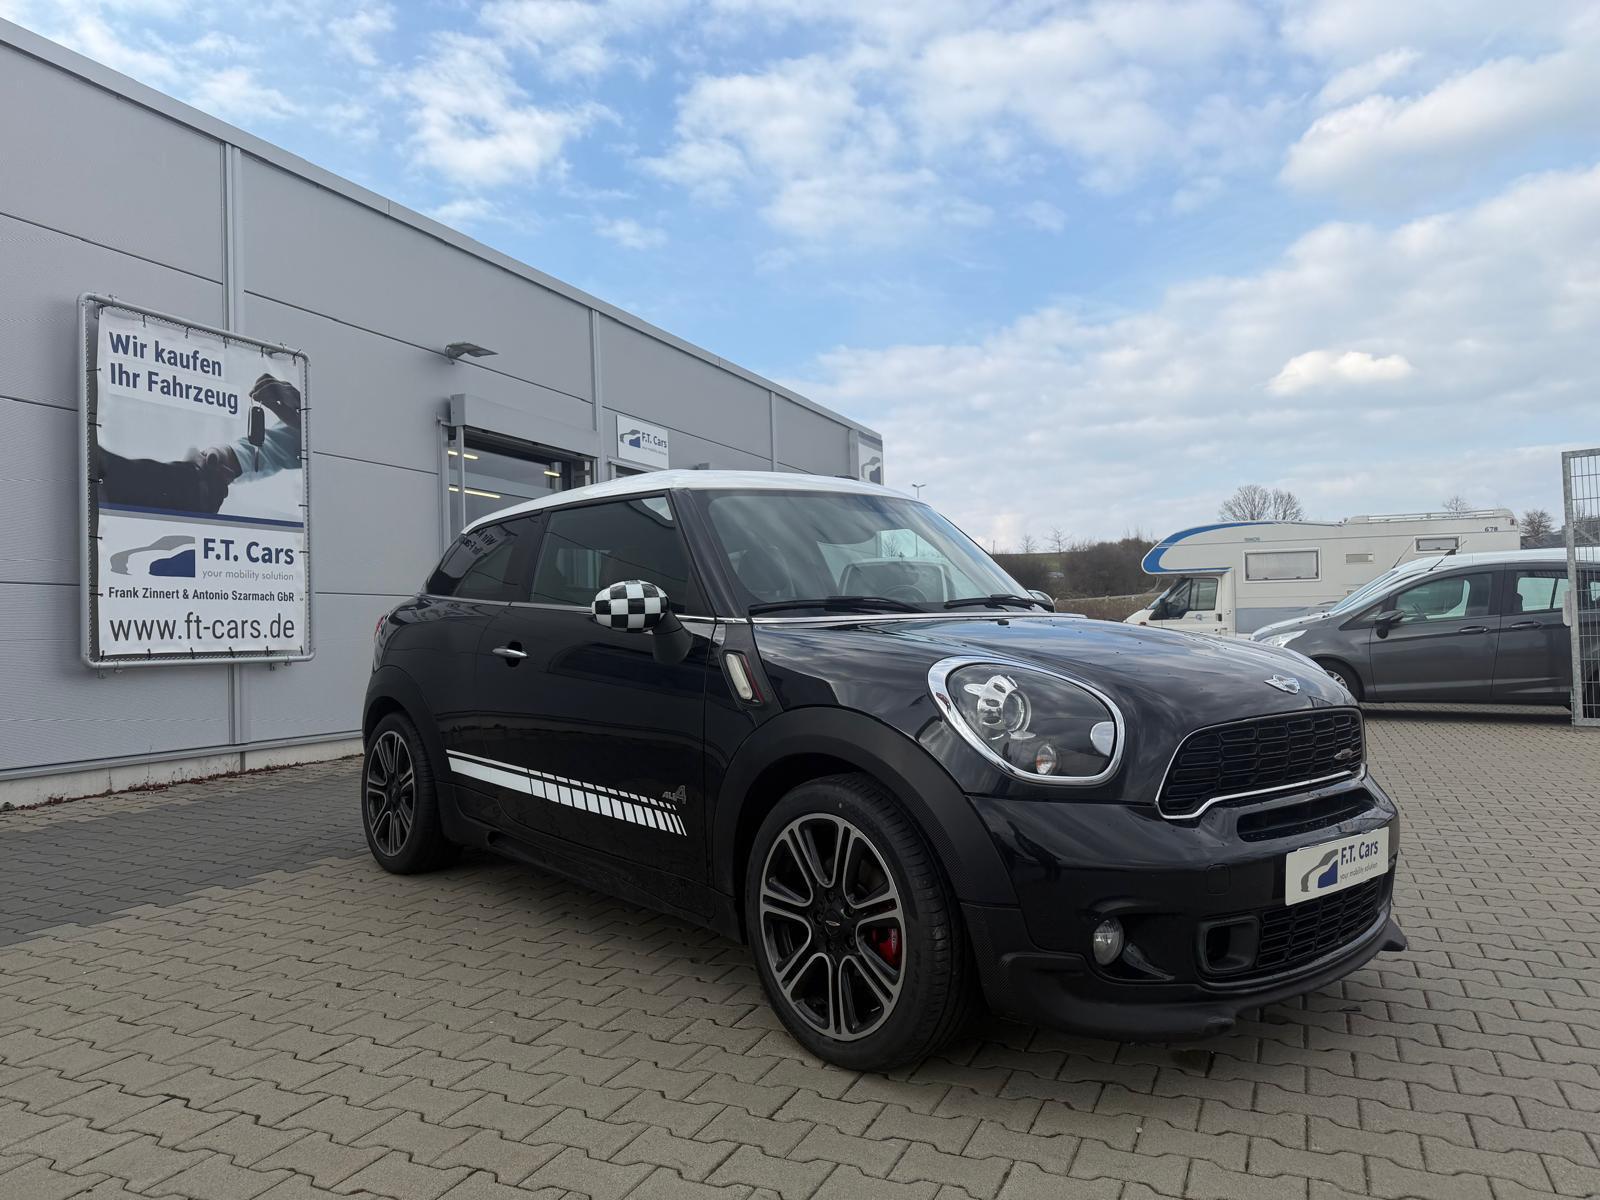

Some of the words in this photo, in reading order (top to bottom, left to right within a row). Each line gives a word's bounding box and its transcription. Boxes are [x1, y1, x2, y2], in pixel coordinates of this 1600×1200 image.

[109, 331, 147, 359] Wir
[154, 340, 222, 377] kaufen
[110, 362, 140, 389] Ihr
[147, 371, 238, 415] Fahrzeug
[653, 436, 667, 448] Cars
[203, 538, 239, 562] F.T.
[246, 541, 294, 565] Cars
[202, 569, 221, 579] your
[225, 570, 260, 581] mobility
[262, 571, 294, 581] solution
[108, 587, 139, 600] Frank
[142, 588, 179, 600] Zinnert
[182, 588, 190, 600] &
[192, 589, 229, 601] Antonio
[231, 590, 275, 602] Szarmach
[277, 591, 295, 602] GbR
[109, 611, 295, 641] www.ft-cars.de
[1340, 845, 1356, 865] F.T.
[1359, 841, 1379, 859] Cars
